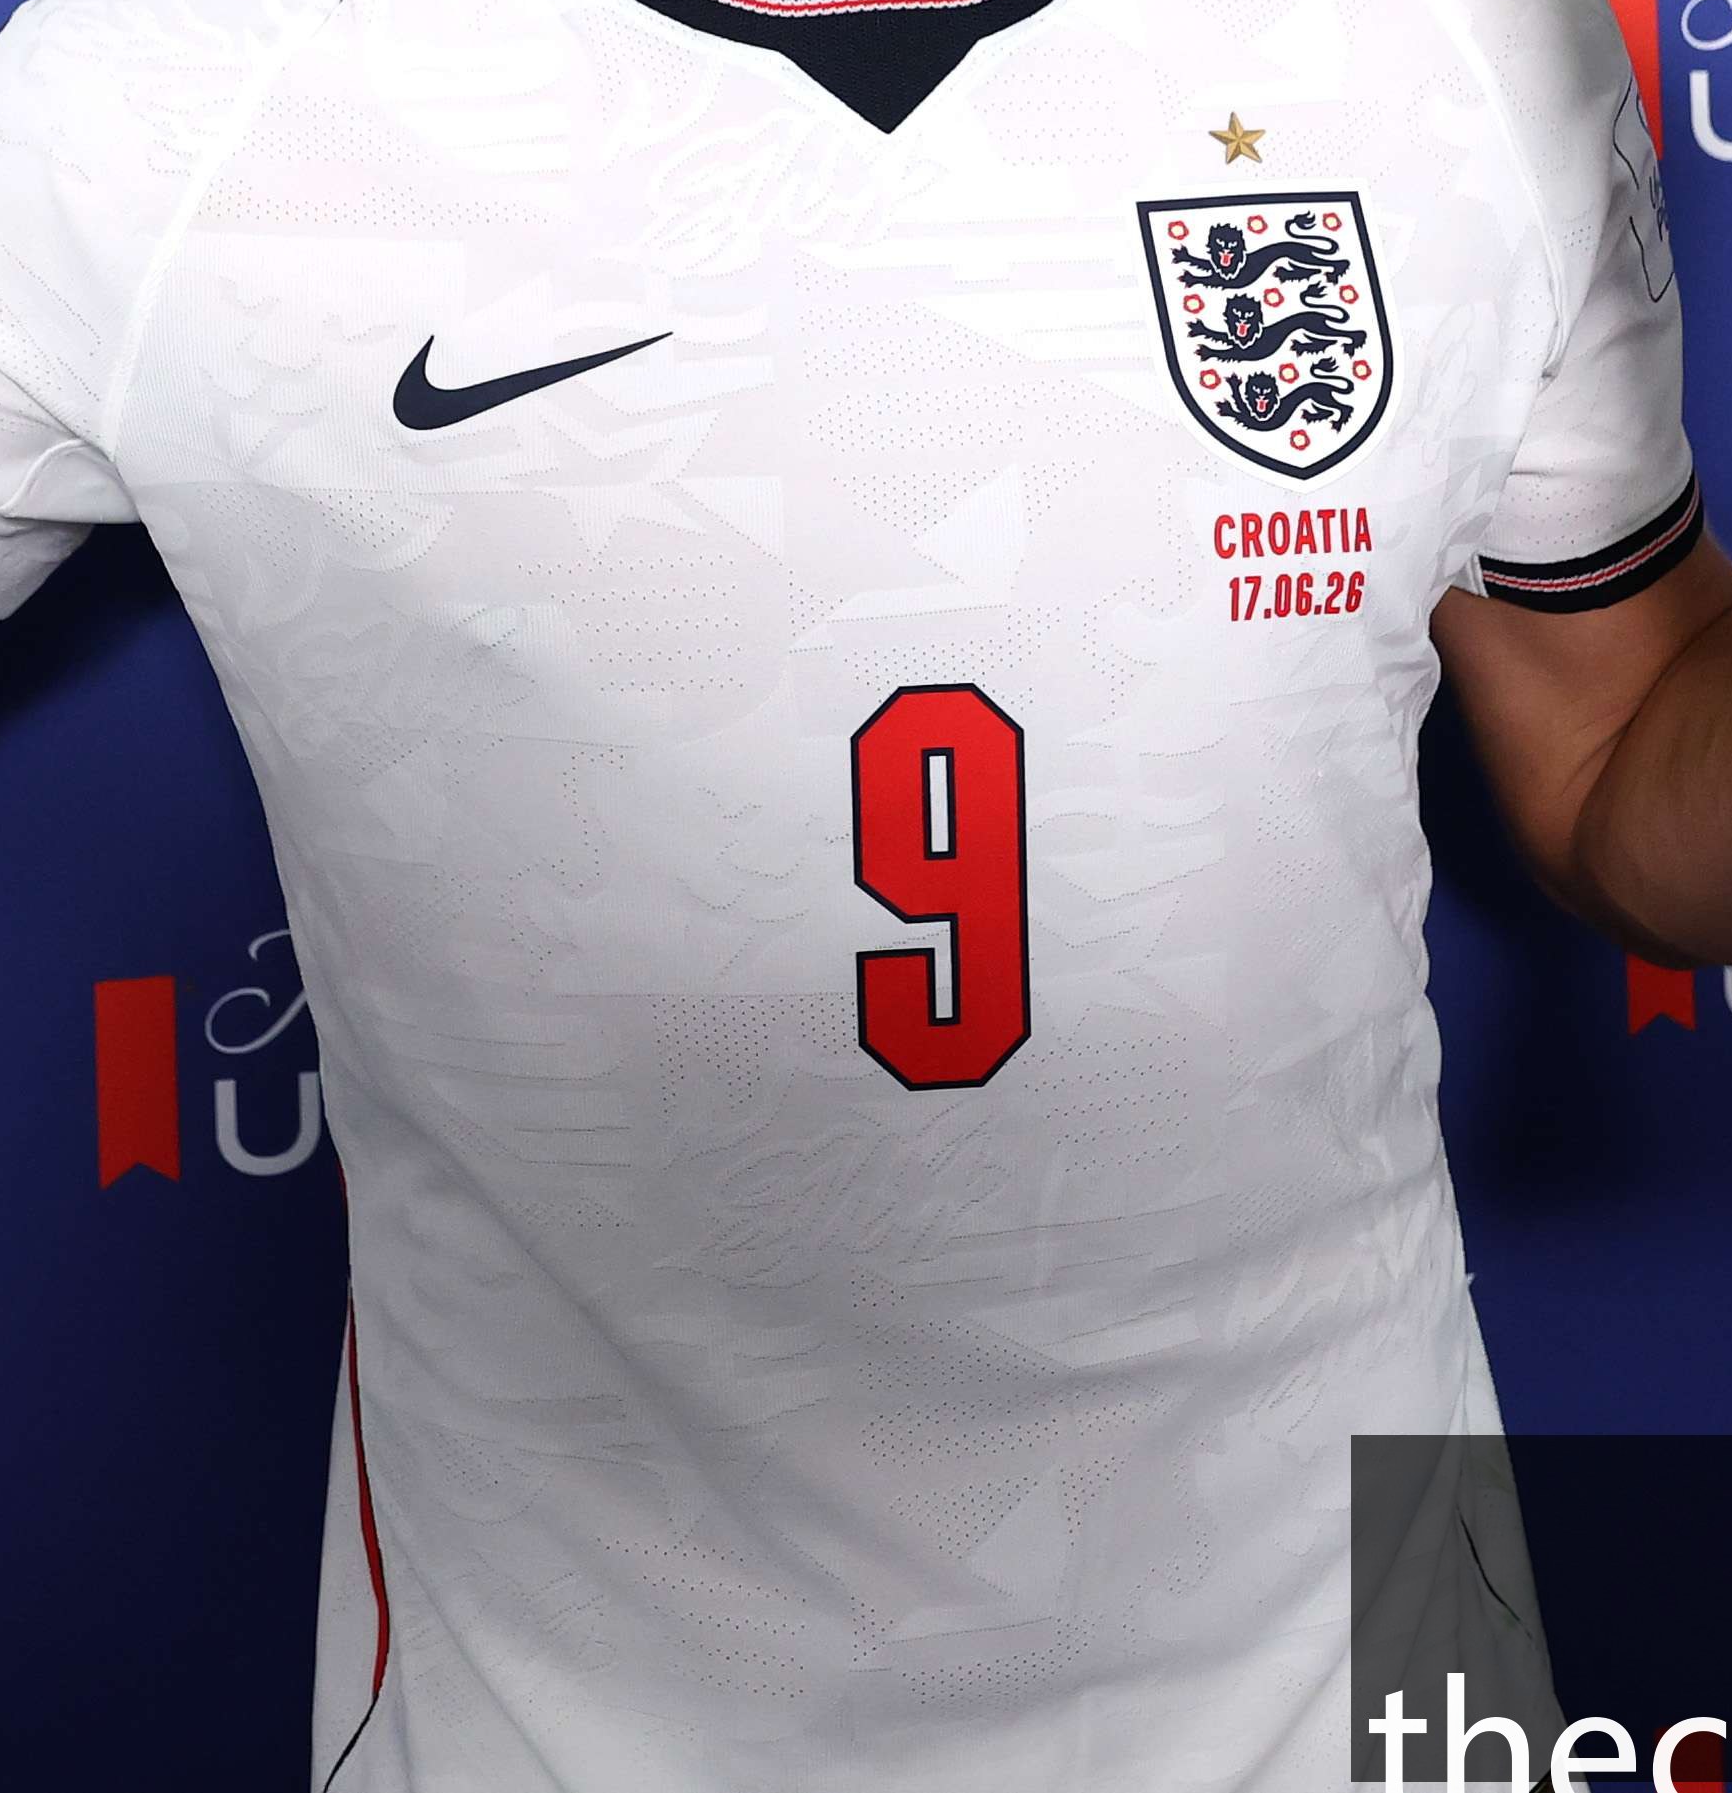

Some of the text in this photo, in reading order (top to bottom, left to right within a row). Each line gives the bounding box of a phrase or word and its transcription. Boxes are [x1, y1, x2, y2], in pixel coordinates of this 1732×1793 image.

[1213, 506, 1373, 560] CROATIA
[1228, 570, 1366, 622] 17.06.26
[850, 682, 1032, 1092] 9
